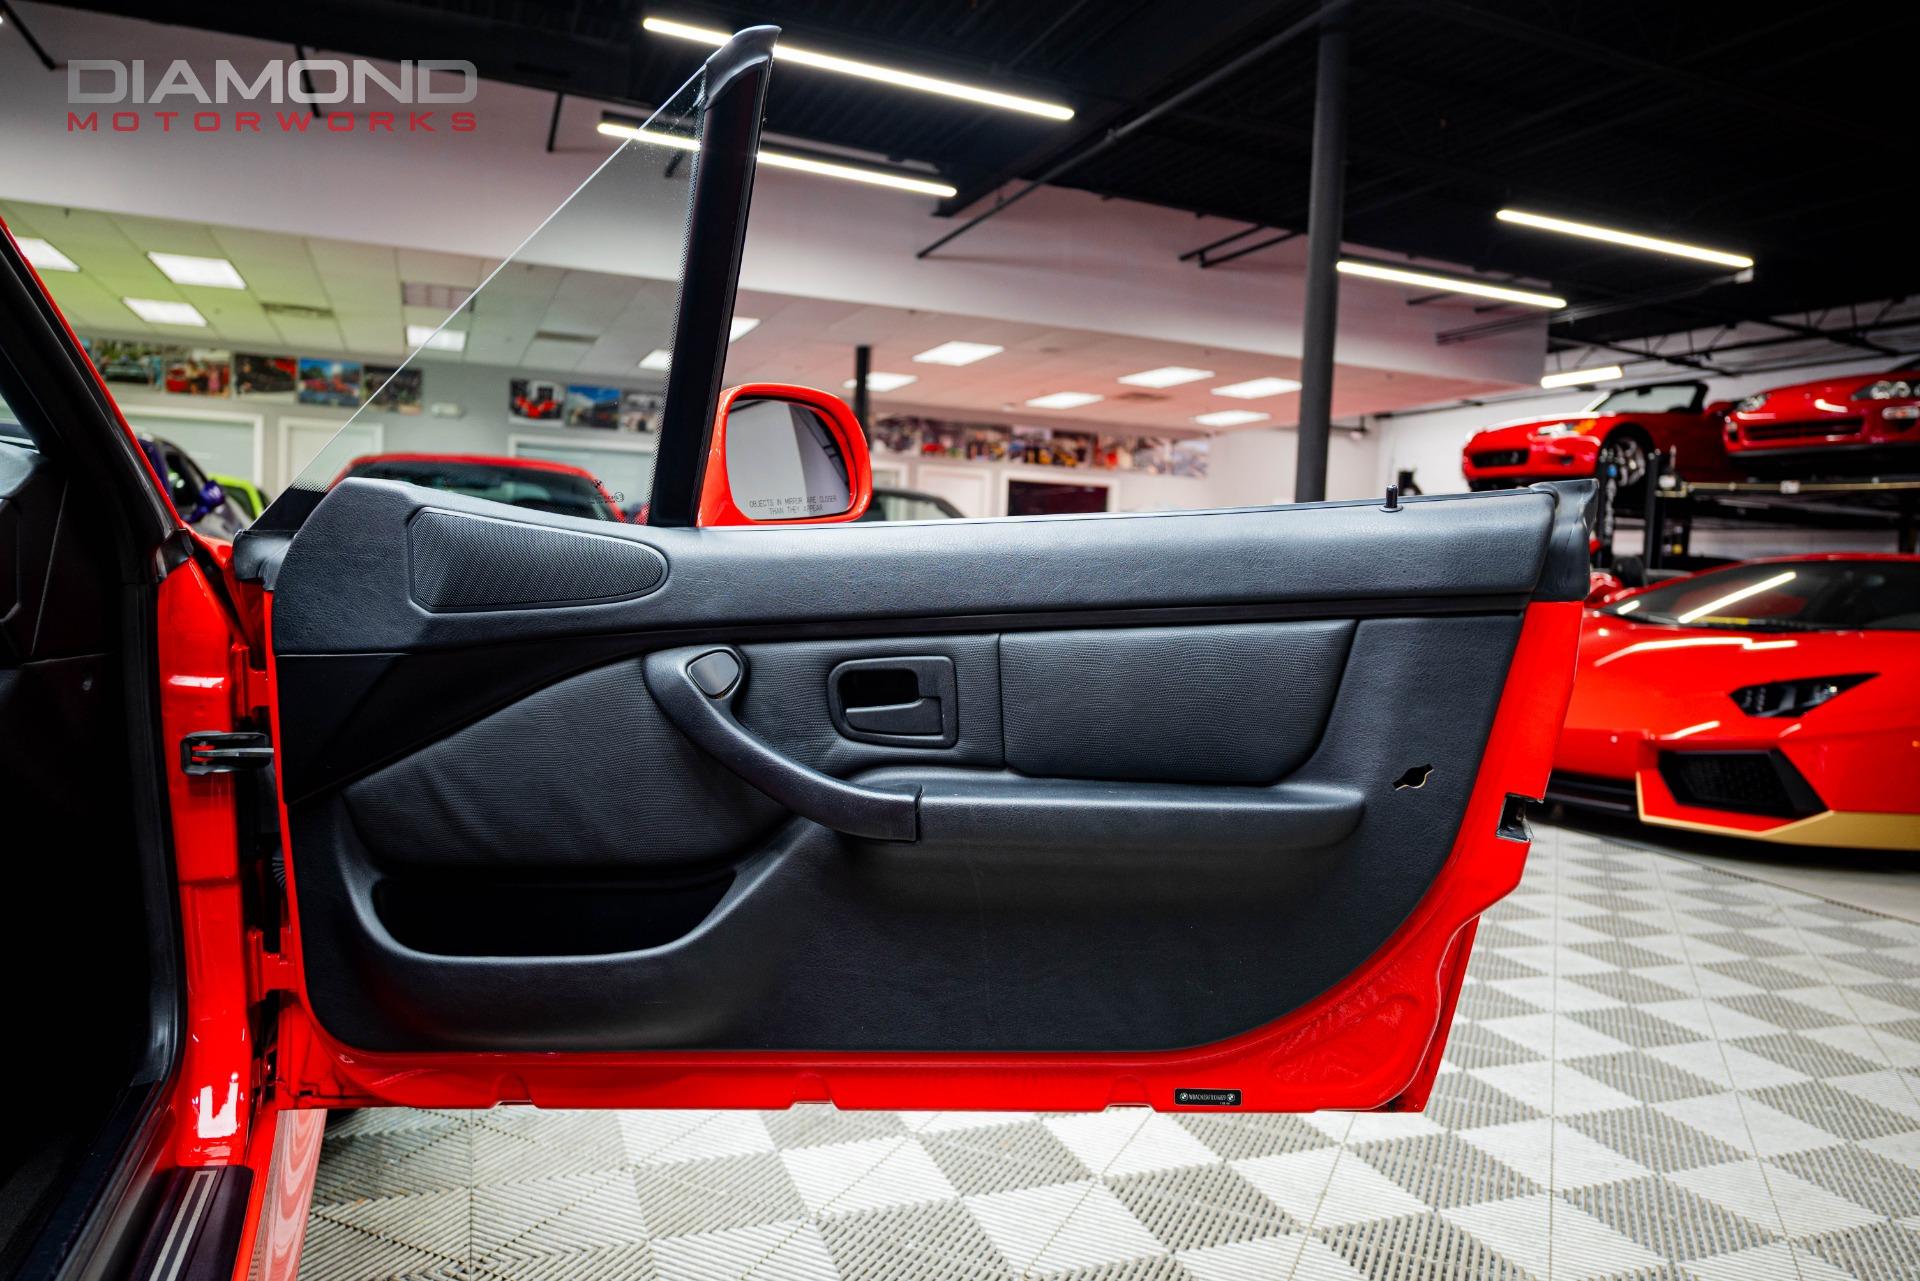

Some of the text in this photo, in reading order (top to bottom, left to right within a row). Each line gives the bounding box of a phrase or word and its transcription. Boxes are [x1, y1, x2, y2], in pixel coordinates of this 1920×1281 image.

[749, 498, 774, 508] OBJECTS
[784, 496, 802, 504] MIRROR
[769, 507, 784, 515] THAN
[787, 506, 800, 514] THEY
